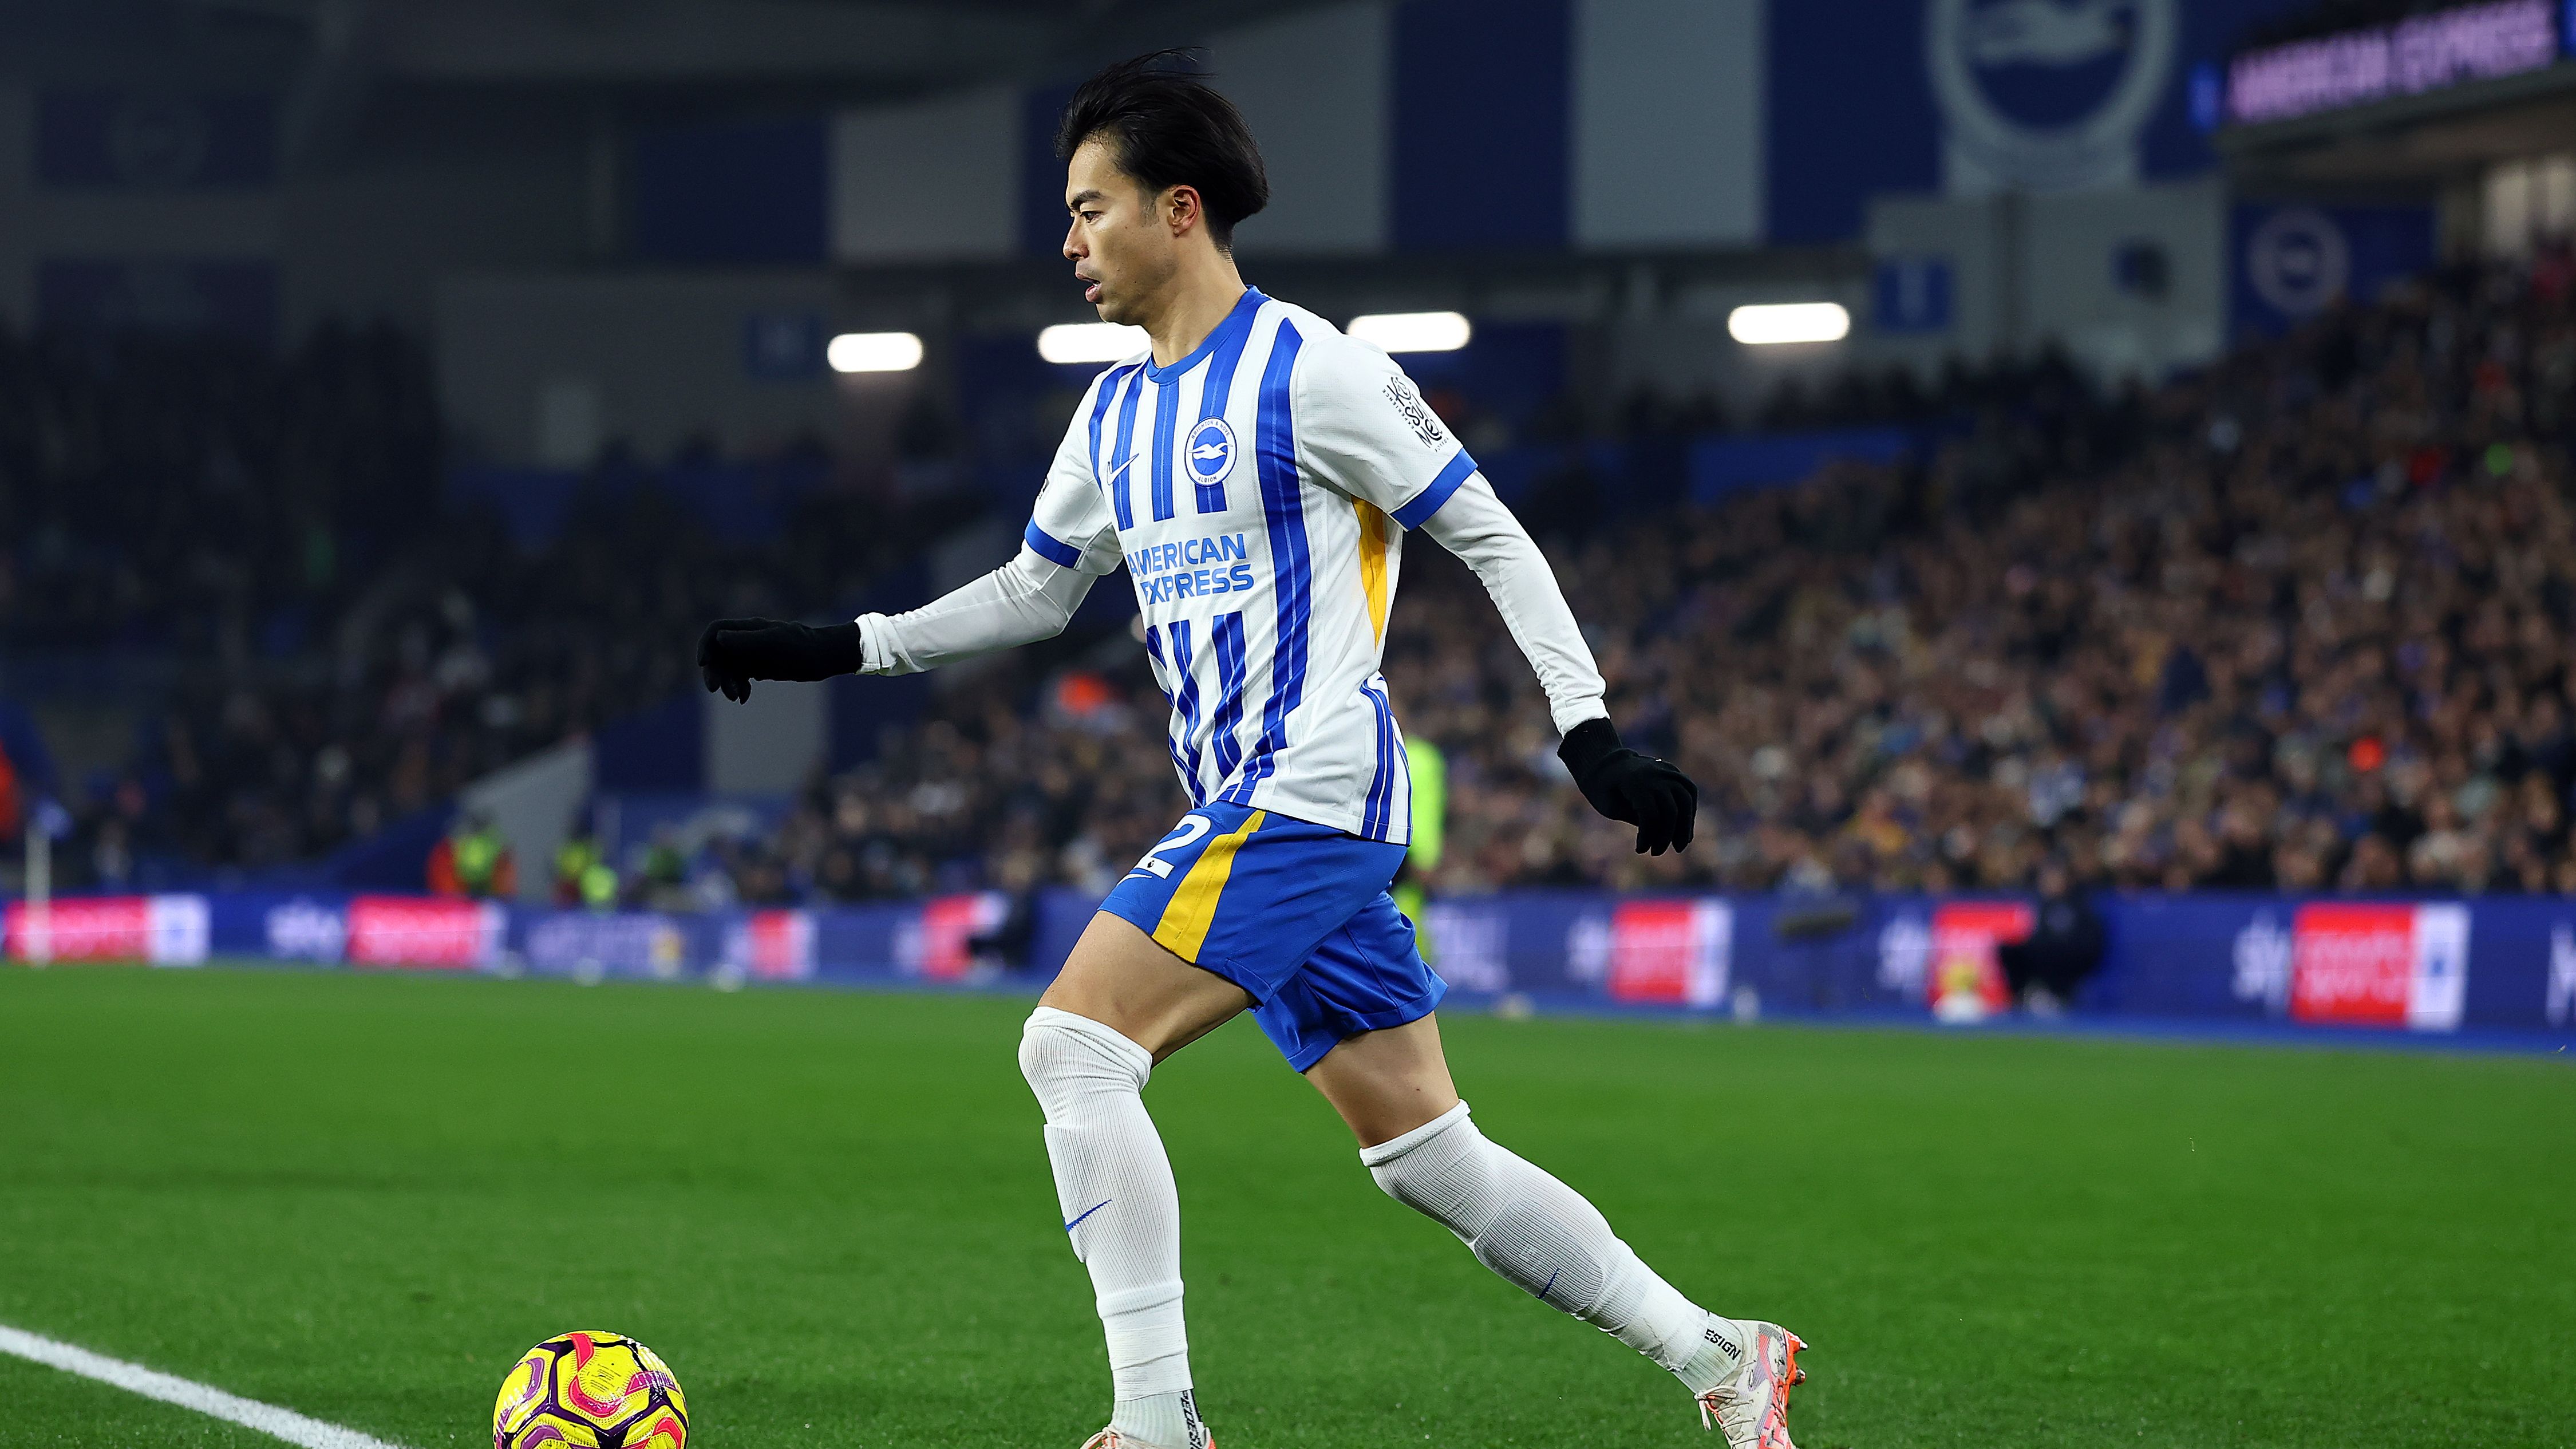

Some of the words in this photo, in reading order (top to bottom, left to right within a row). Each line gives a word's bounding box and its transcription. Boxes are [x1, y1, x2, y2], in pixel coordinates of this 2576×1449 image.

[1382, 389, 1415, 429] EXPERIENCE
[1191, 420, 1214, 439] BRIGHTON
[1220, 423, 1231, 437] HOVE
[1198, 475, 1218, 483] ALBION
[1127, 533, 1247, 578] AMERICAN
[1140, 563, 1254, 606] EXPRESS
[1132, 814, 1212, 879] 2
[1704, 1328, 1741, 1360] ESIGN
